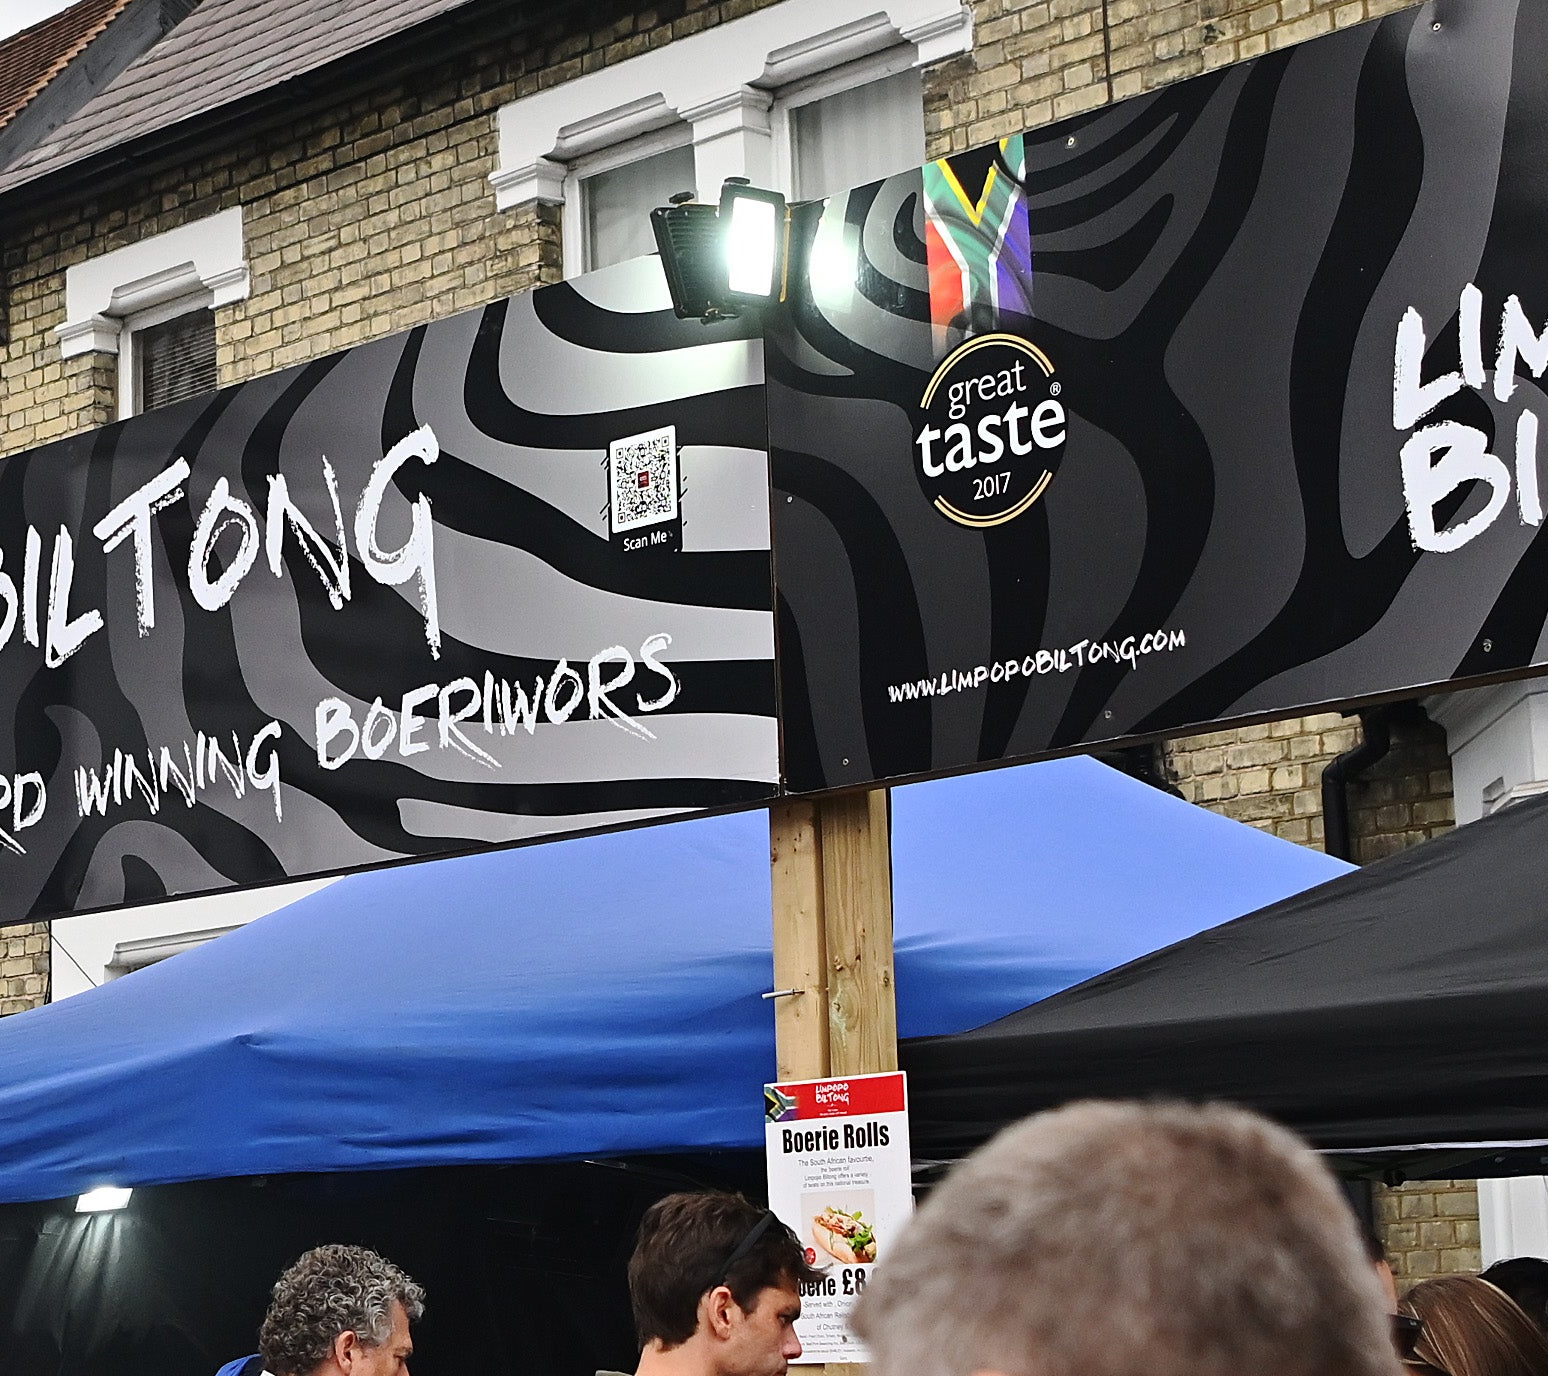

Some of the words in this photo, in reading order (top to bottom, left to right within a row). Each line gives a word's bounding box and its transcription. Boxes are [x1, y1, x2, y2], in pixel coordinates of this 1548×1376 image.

[948, 360, 1027, 419] great
[915, 399, 1066, 477] taste
[972, 471, 1012, 501] 2017
[623, 535, 648, 552] Scan
[650, 530, 667, 545] Me
[76, 720, 282, 822] WINNING
[315, 632, 681, 771] BOERIWORS
[782, 1126, 839, 1154] Boerie
[844, 1122, 889, 1149] Rolls
